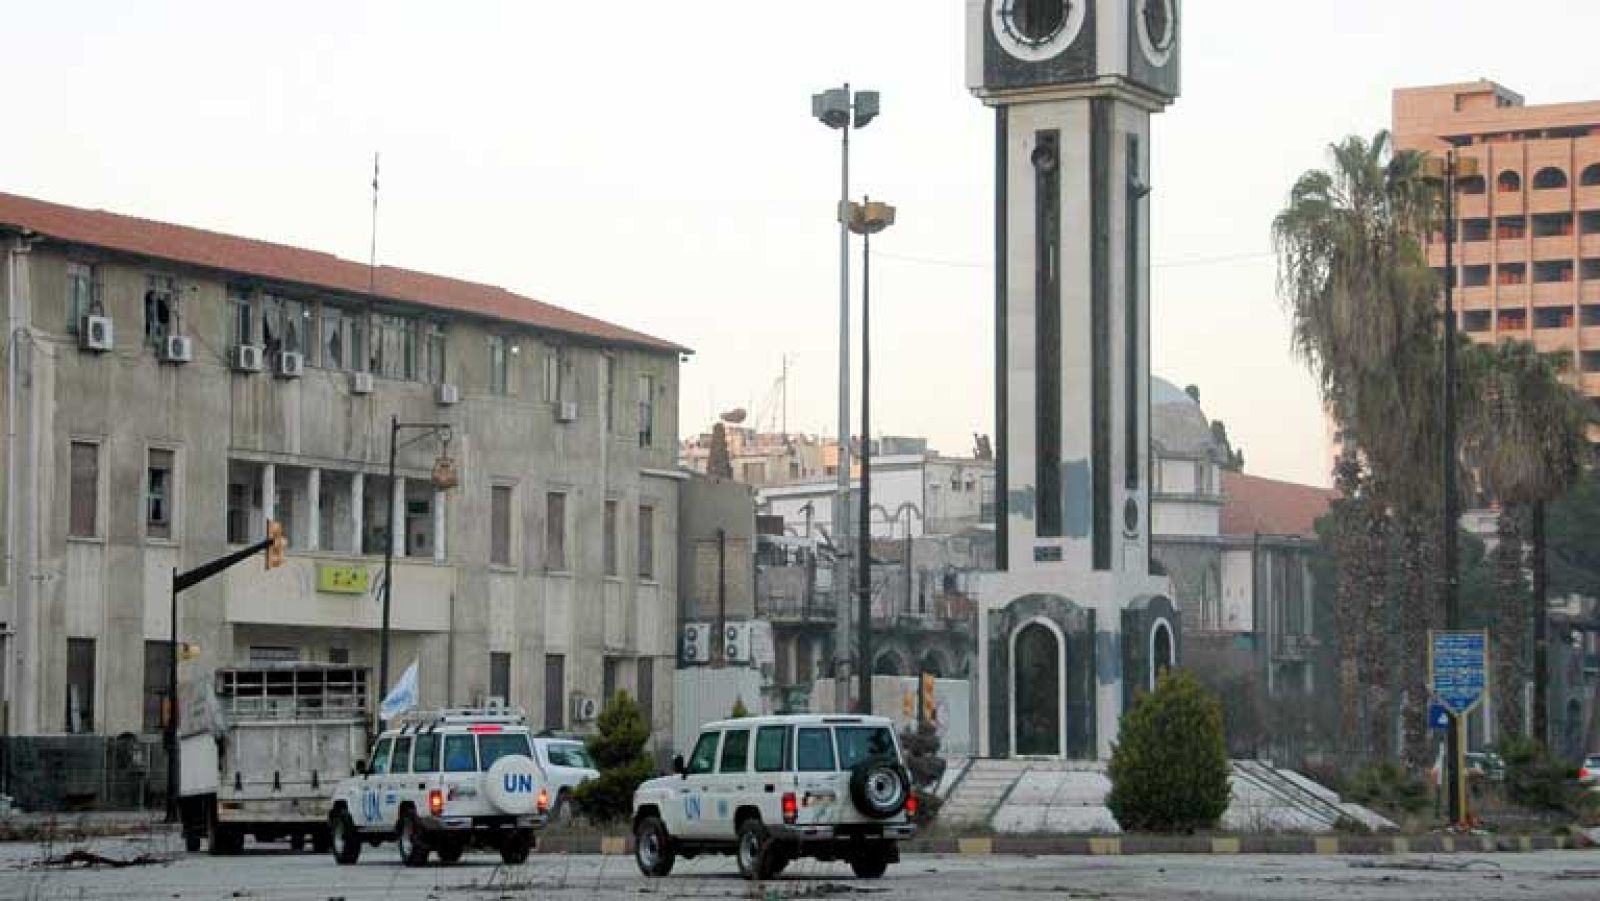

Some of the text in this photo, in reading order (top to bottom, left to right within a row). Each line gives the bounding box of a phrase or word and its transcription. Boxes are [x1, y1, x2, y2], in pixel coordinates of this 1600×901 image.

[503, 773, 532, 793] UN
[362, 789, 382, 822] UN
[684, 792, 701, 820] UN
